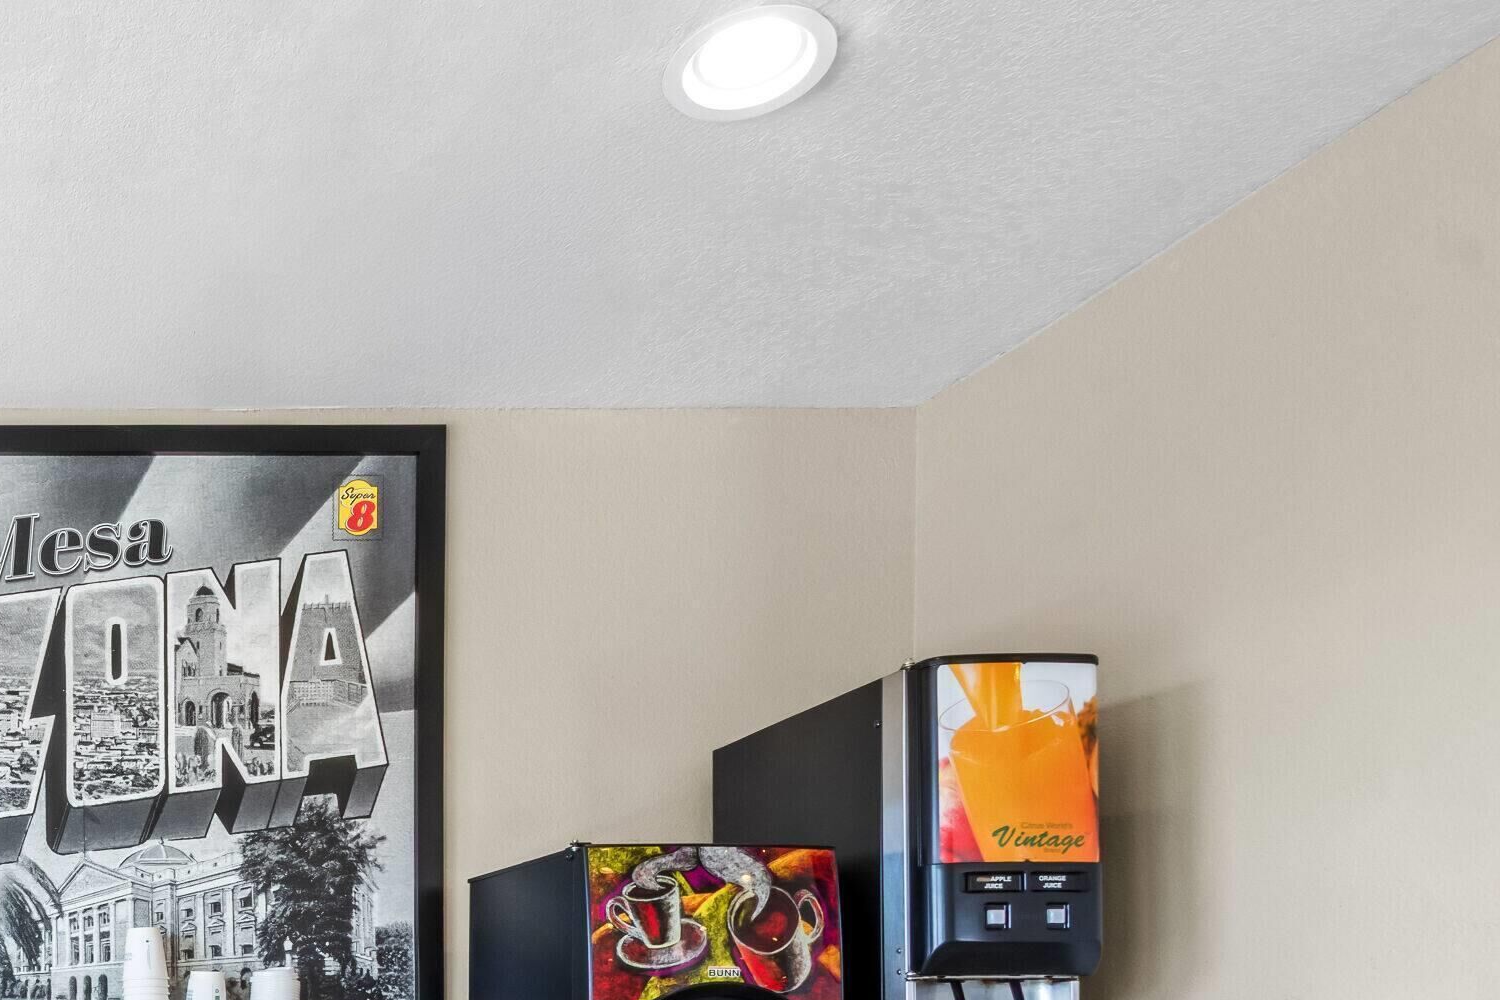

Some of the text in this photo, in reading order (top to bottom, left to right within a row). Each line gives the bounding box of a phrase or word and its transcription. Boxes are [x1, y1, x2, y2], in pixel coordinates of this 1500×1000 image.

[341, 486, 376, 505] Super
[345, 500, 376, 533] 8
[991, 825, 1085, 855] Vintage
[708, 969, 740, 977] BUNN
